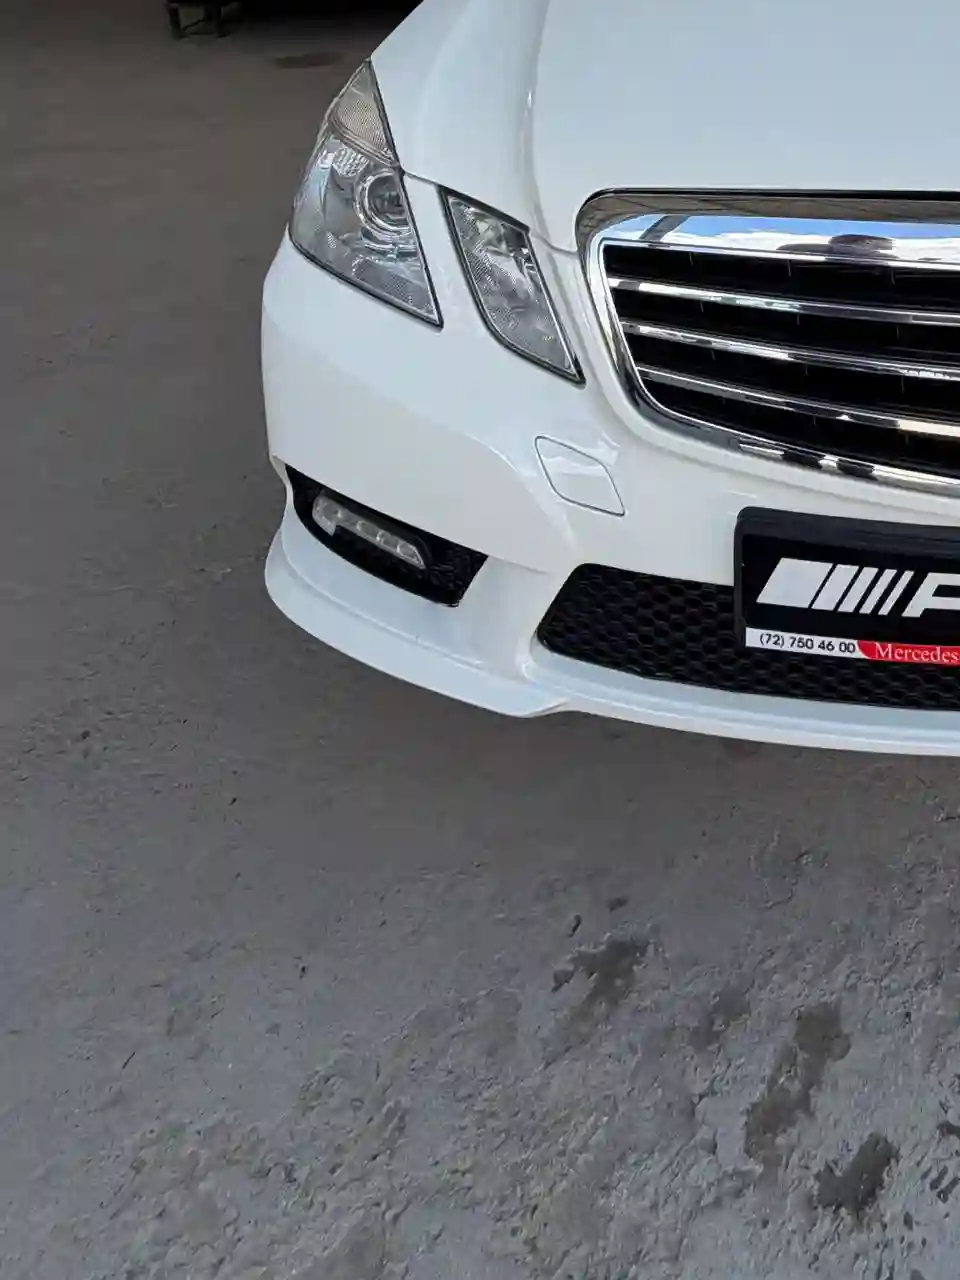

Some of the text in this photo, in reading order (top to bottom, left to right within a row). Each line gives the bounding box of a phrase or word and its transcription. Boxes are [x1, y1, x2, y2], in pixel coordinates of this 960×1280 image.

[760, 632, 856, 654] (72) 750 46 00
